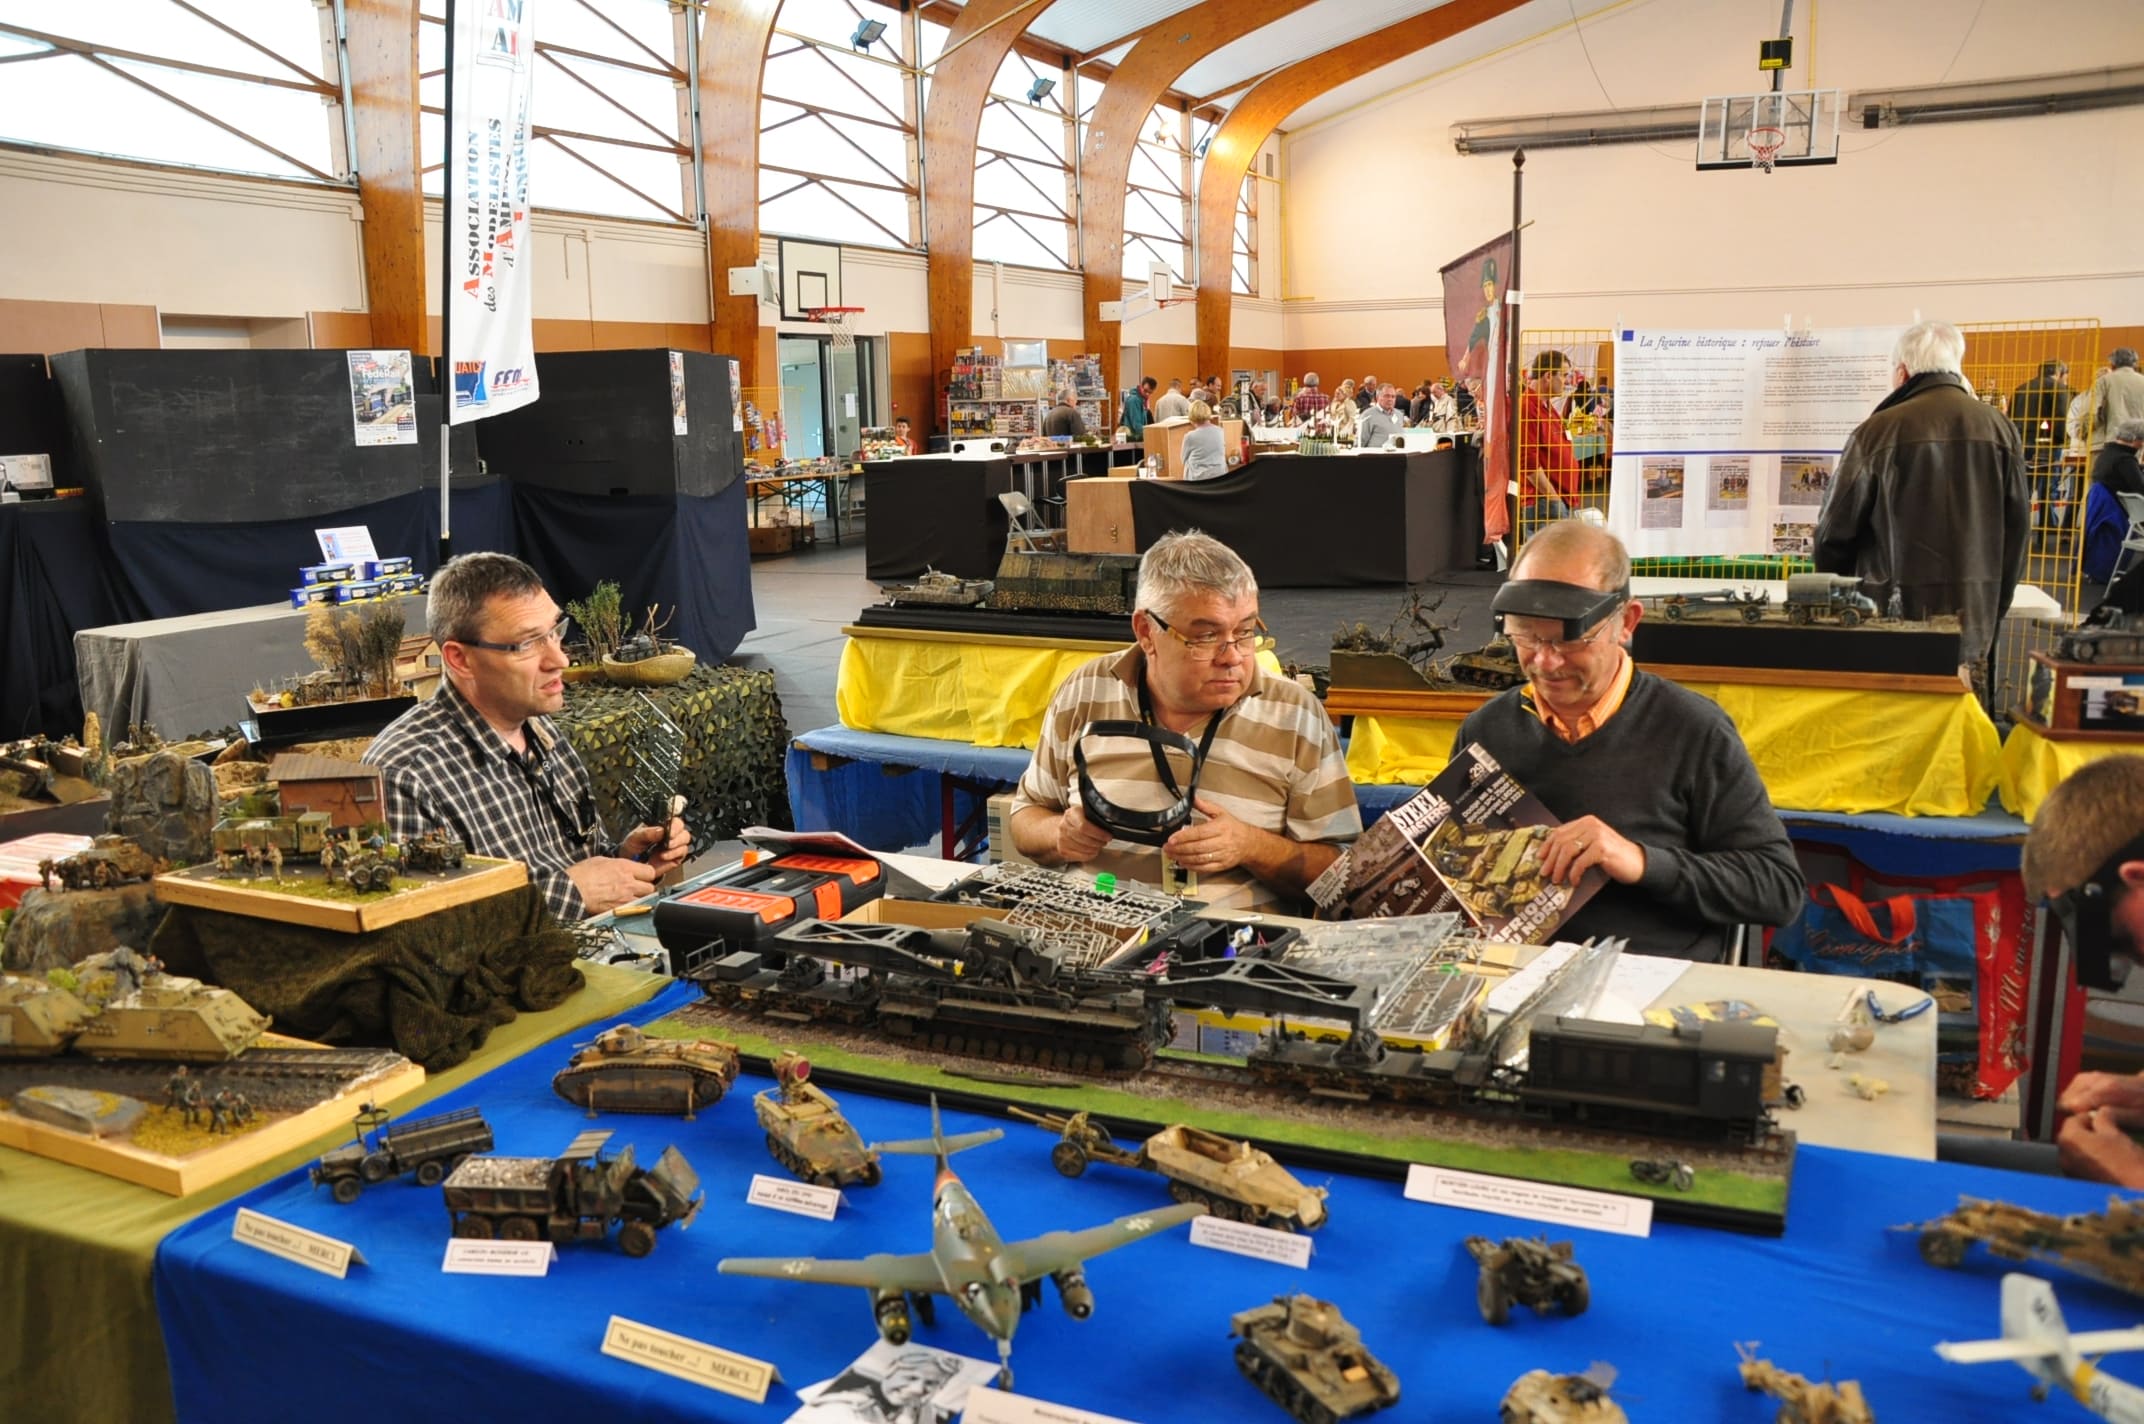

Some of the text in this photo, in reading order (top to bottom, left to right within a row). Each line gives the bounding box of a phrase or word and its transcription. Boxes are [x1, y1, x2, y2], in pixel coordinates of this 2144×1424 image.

[463, 130, 481, 299] ASSOCIATION
[484, 285, 497, 313] des
[1640, 336, 1653, 347] La
[1655, 336, 1691, 350] figurine
[1696, 336, 1736, 351] historique
[1752, 338, 1780, 351] rejouer
[1391, 789, 1445, 829] STEEL
[1521, 891, 1566, 936] NORD
[650, 1344, 686, 1364] toucher
[710, 1360, 751, 1384] MERCI
